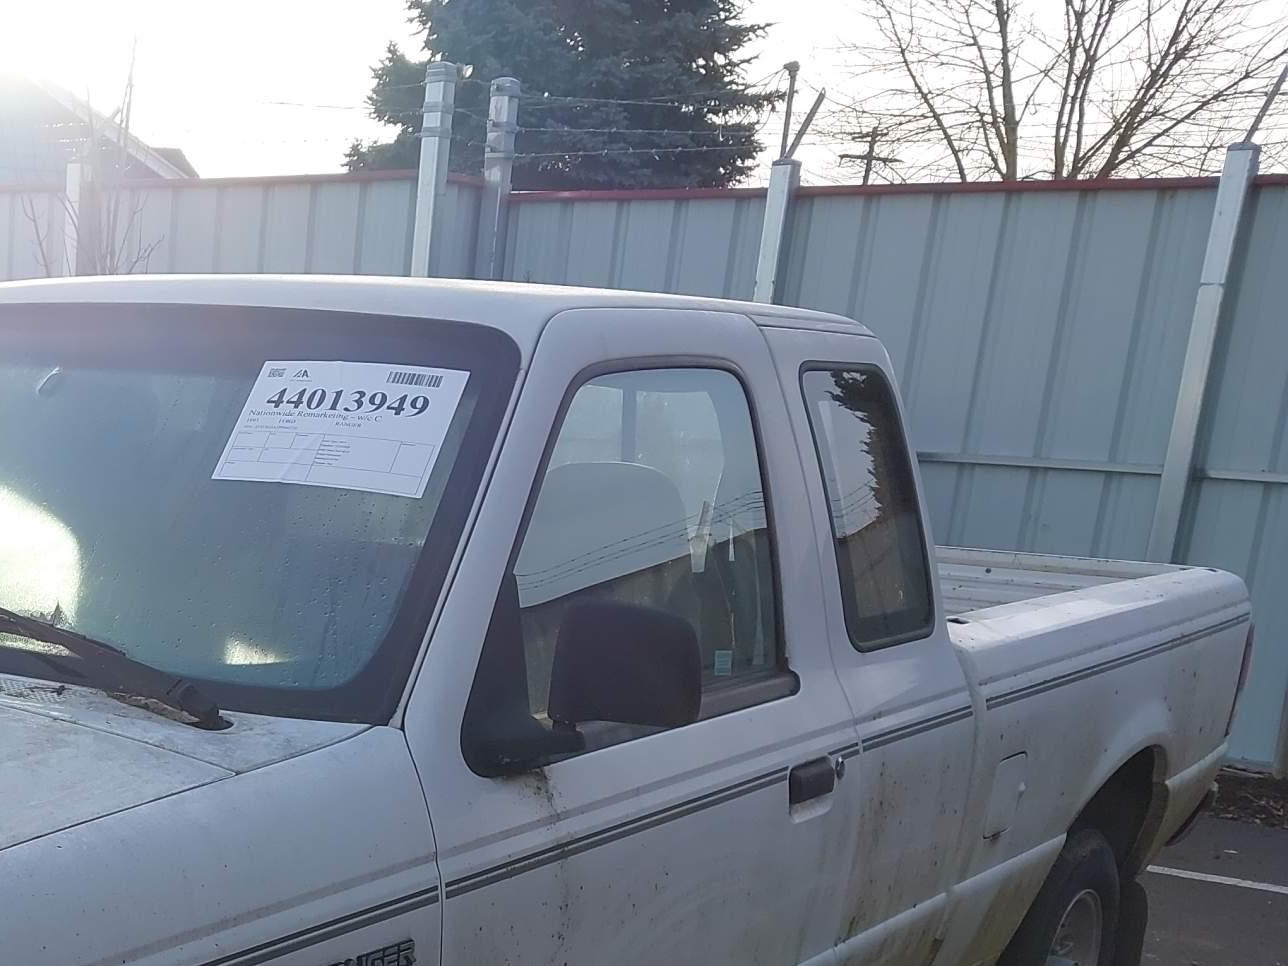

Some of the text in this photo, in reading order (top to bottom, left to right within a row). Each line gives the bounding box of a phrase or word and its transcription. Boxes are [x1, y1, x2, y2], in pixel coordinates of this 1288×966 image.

[266, 387, 430, 418] 44013949
[249, 409, 296, 417] Nationwide
[297, 410, 349, 421] Remarketing
